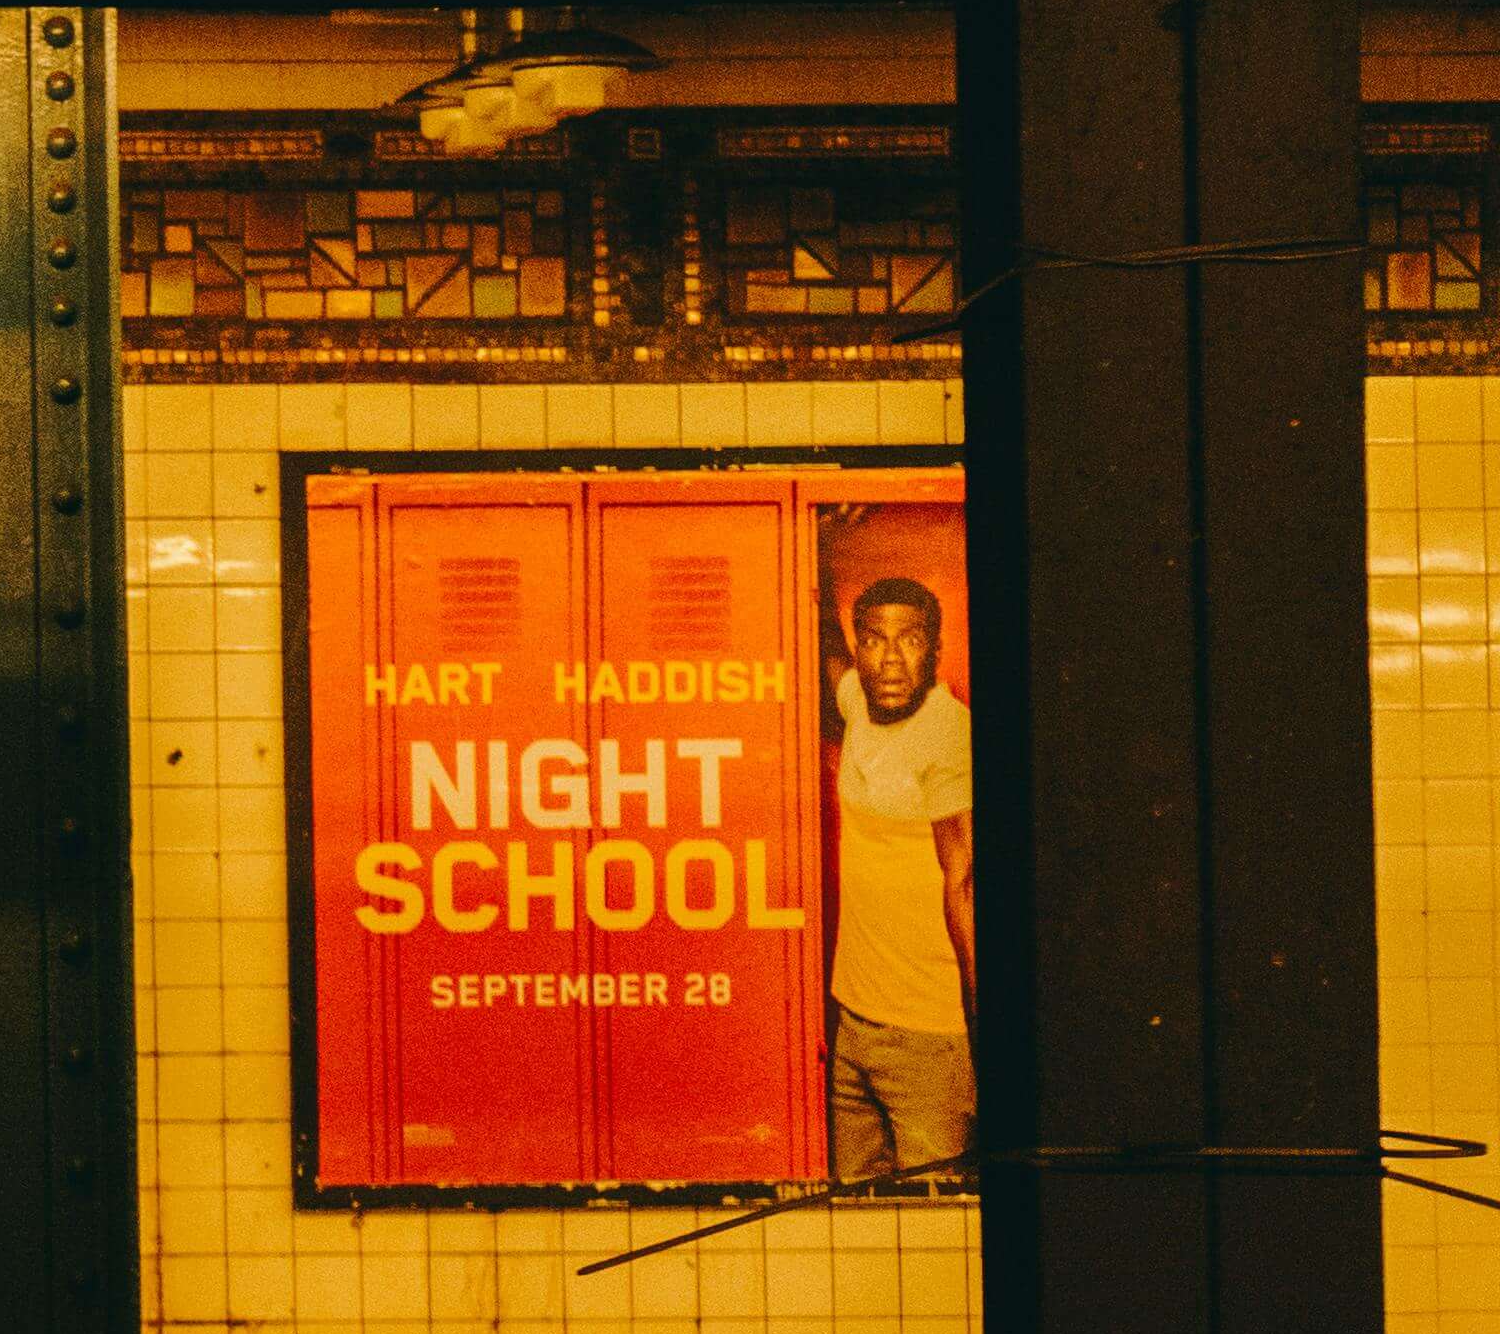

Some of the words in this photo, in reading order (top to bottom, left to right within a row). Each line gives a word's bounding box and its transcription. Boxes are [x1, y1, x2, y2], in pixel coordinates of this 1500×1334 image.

[366, 664, 502, 706] HART
[555, 661, 786, 704] HADDISH
[409, 739, 743, 831] NIGHT
[355, 839, 805, 935] SCHOOL
[431, 975, 668, 1009] SEPTEMBER
[684, 975, 732, 1005] 28
